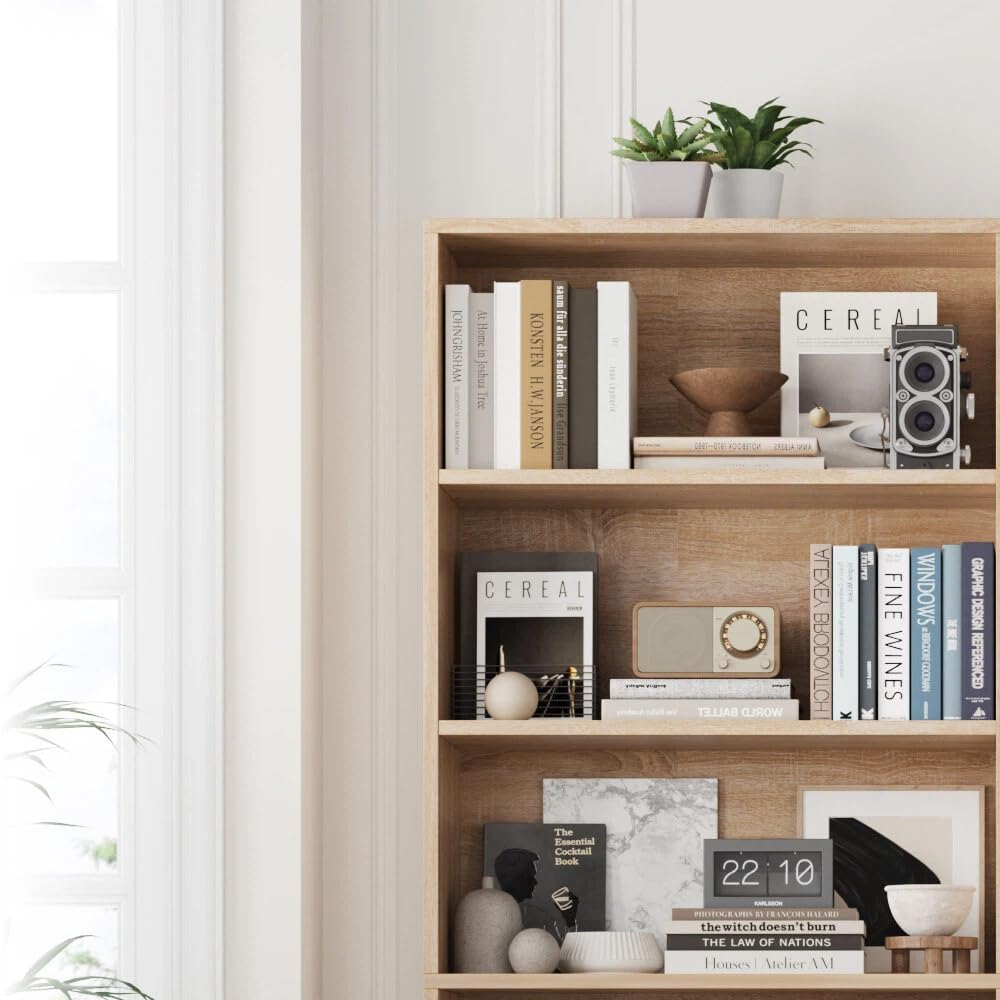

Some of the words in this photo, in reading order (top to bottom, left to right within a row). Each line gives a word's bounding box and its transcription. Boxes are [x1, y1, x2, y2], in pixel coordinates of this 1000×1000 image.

[556, 286, 565, 307] saum
[477, 310, 487, 319] At
[556, 311, 566, 323] für
[477, 324, 487, 347] Home
[530, 313, 544, 368] KONSTEN
[556, 326, 566, 341] alla
[556, 344, 566, 356] die
[475, 360, 487, 388] Joshua
[556, 360, 566, 397] sünderin
[477, 392, 487, 409] Tree
[971, 558, 984, 596] GRAPHIC
[485, 580, 585, 598] CEREAL
[885, 573, 902, 620] FINE
[917, 553, 935, 626] WINDOWS
[971, 598, 984, 630] DESIGN
[885, 630, 903, 700] WINES
[971, 633, 984, 689] REFERENCED
[555, 837, 595, 846] Essential
[555, 847, 592, 856] Cocktail
[555, 858, 579, 866] Book
[722, 860, 760, 885] 22
[779, 859, 814, 885] 10
[701, 922, 720, 932] the
[723, 922, 757, 932] witch
[808, 922, 836, 932] burn
[702, 938, 727, 947] THE
[730, 938, 755, 947] LAW
[759, 938, 775, 947] OF
[779, 938, 831, 947] NATIONS
[705, 957, 750, 969] Houses
[764, 957, 804, 969] Atelier
